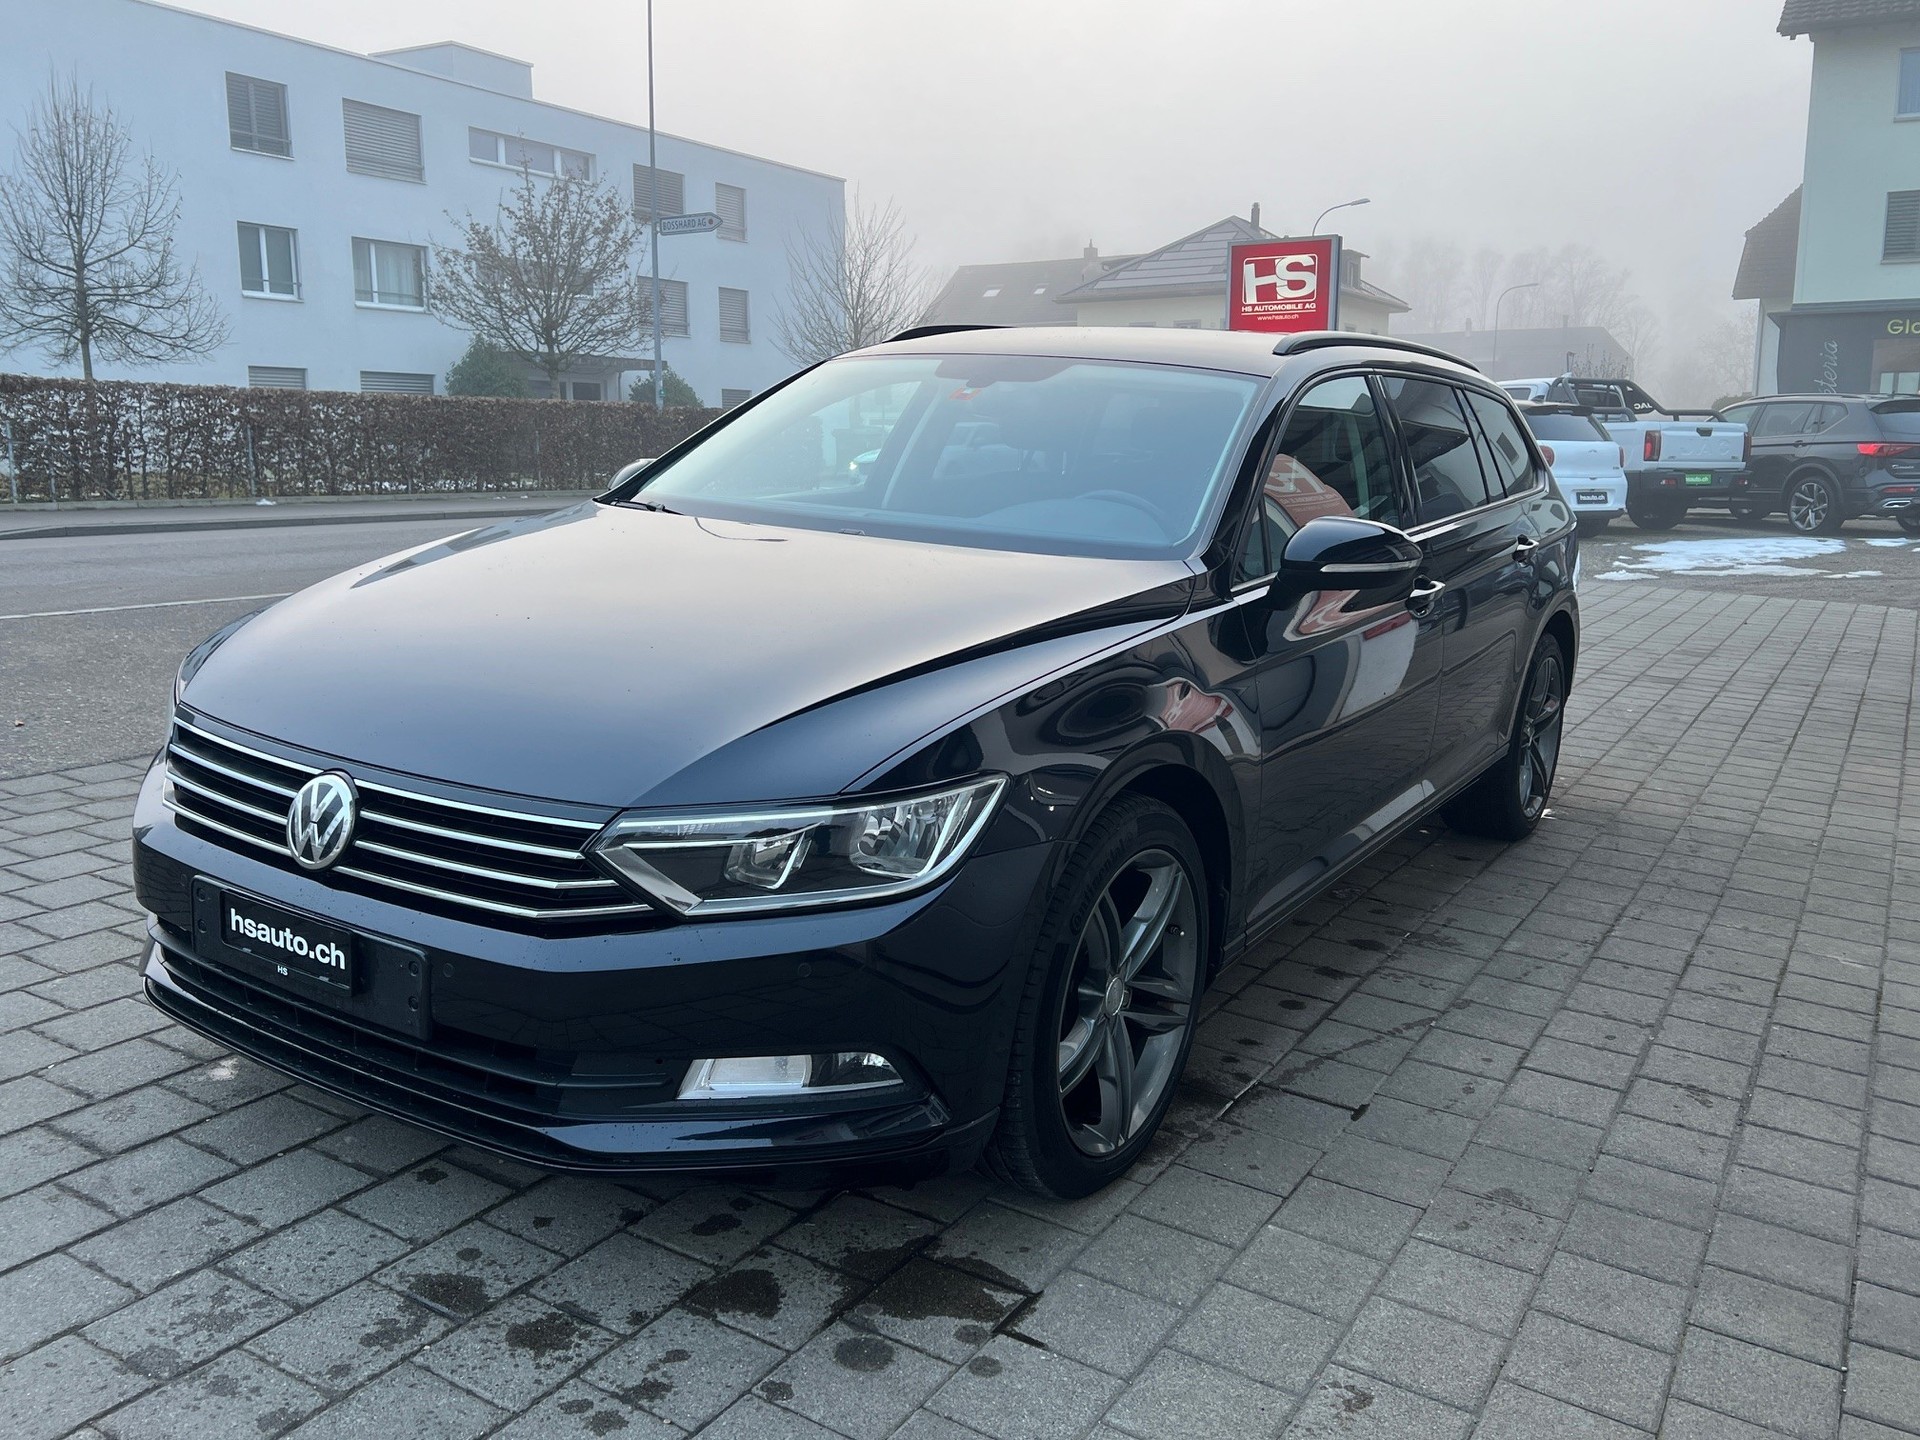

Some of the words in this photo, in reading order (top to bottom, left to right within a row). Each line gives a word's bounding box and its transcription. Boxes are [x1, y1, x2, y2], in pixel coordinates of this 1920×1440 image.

[663, 219, 696, 231] BOSSHARD
[697, 218, 707, 227] AG
[1244, 255, 1316, 303] HS
[1253, 303, 1303, 311] AUTOMOBILE
[230, 908, 346, 970] hsauto.ch
[277, 965, 288, 976] HS
